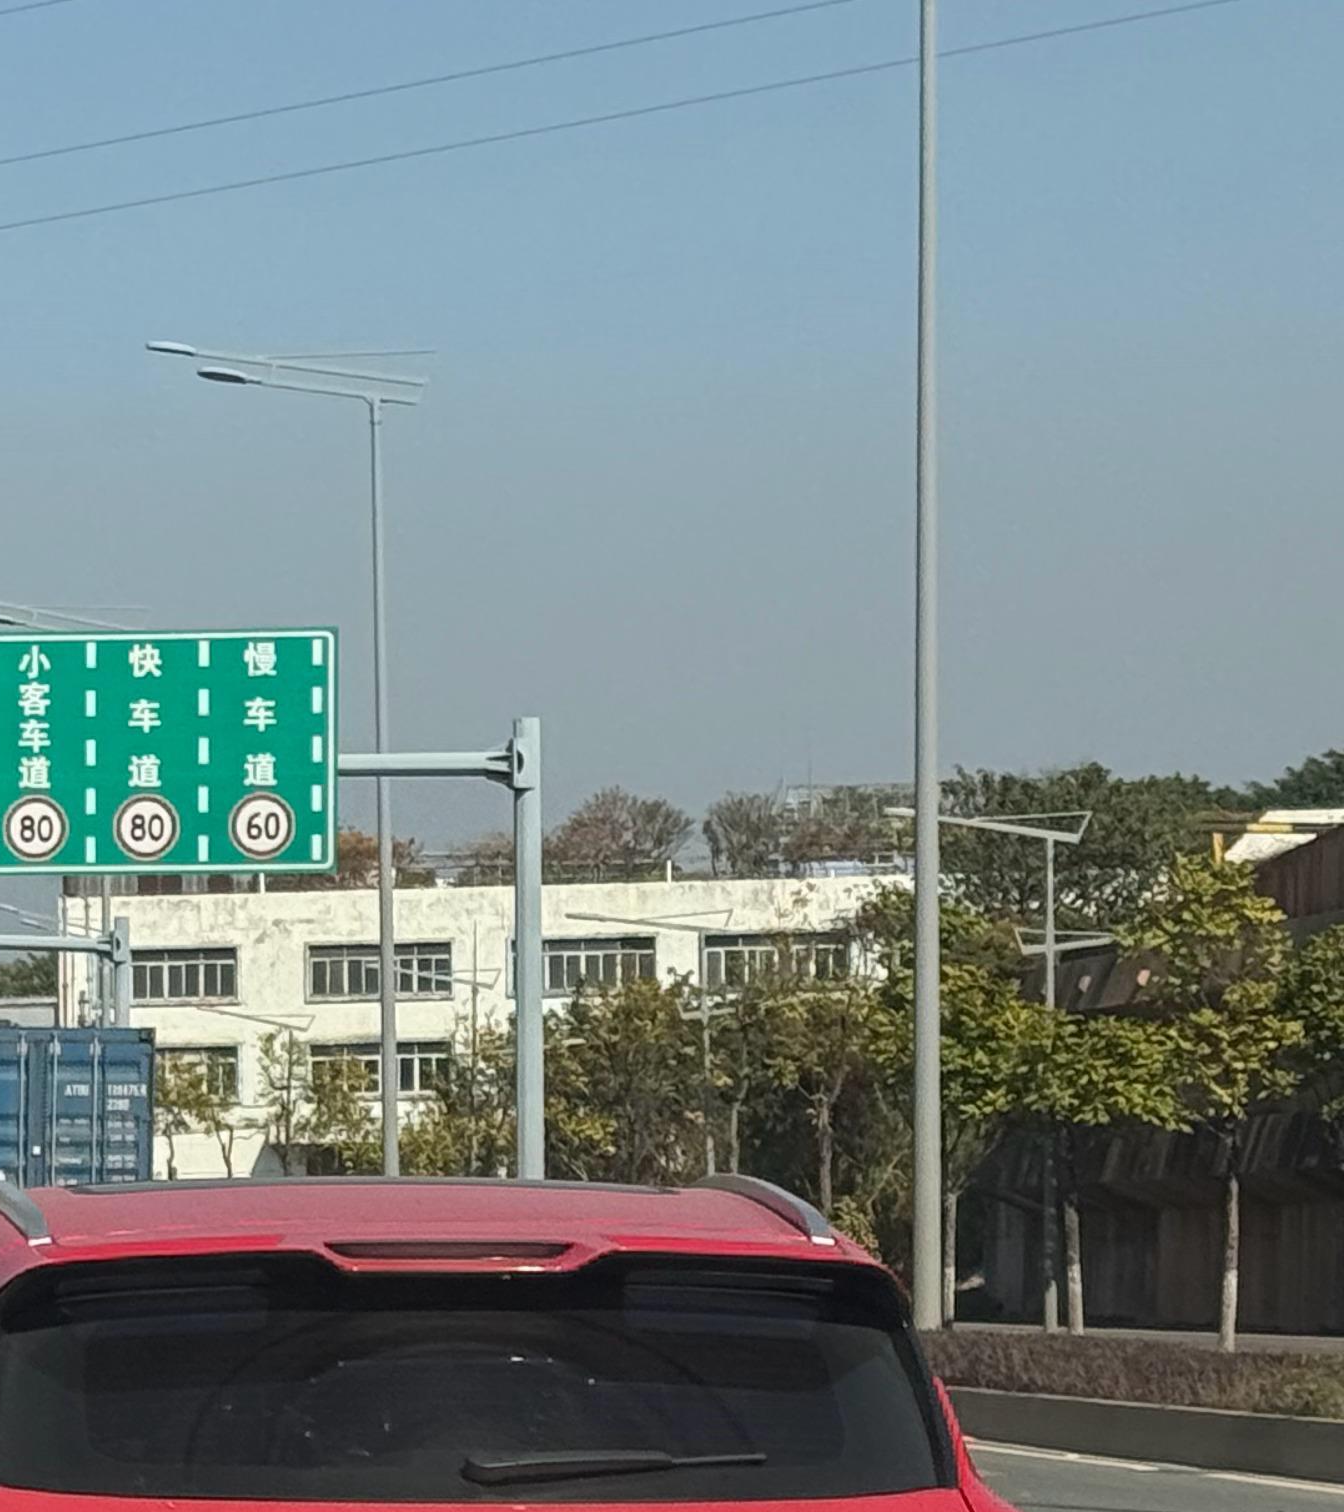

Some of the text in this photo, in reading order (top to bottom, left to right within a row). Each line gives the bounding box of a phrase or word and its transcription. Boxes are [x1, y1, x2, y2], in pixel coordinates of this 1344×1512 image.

[18, 645, 51, 788] 小客车道
[128, 643, 162, 787] 快车道
[243, 641, 278, 786] 慢车道
[20, 815, 54, 843] 80
[130, 814, 164, 841] 80
[246, 812, 280, 840] 60
